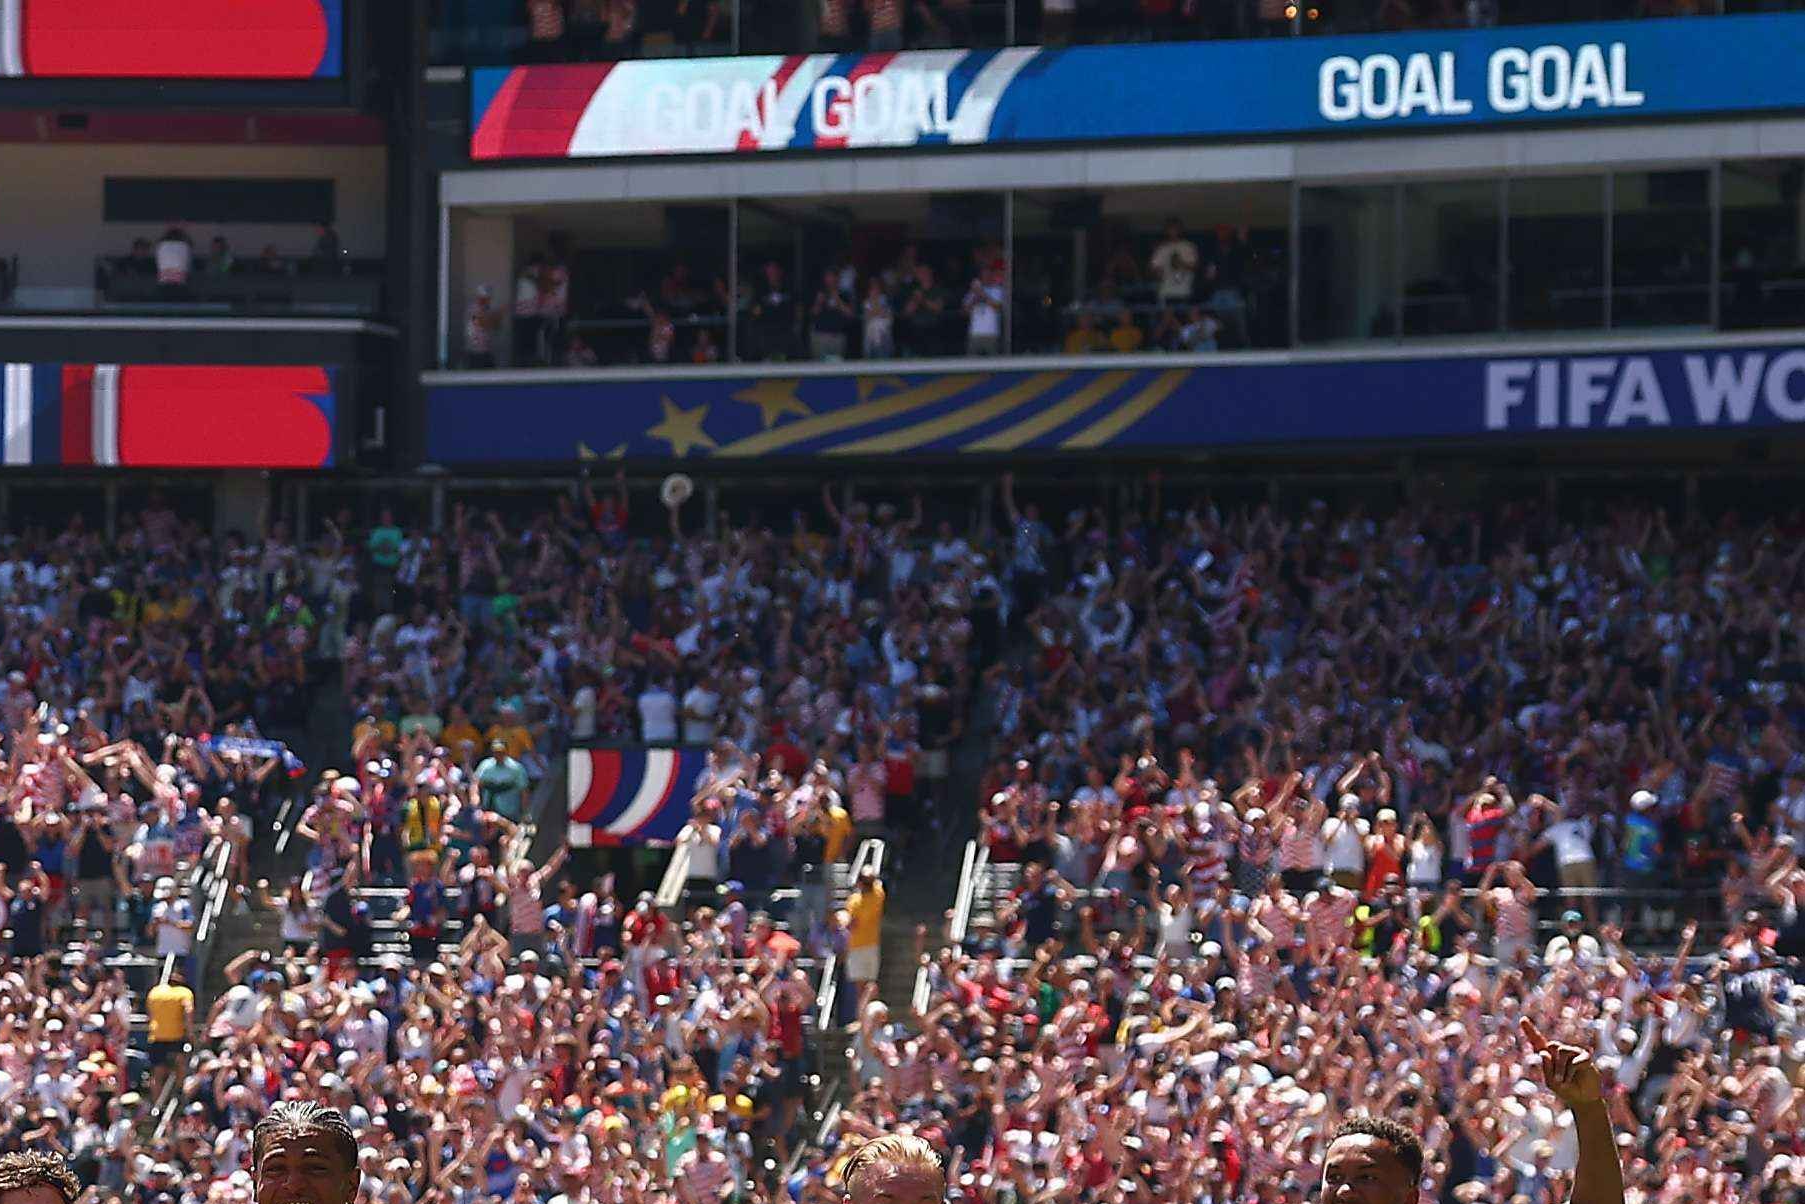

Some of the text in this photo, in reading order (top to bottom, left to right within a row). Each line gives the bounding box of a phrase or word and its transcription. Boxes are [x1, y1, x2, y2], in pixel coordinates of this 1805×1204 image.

[648, 68, 959, 142] GOAL GOAL
[1319, 42, 1645, 121] GOAL GOAL
[1485, 357, 1670, 430] FIFA
